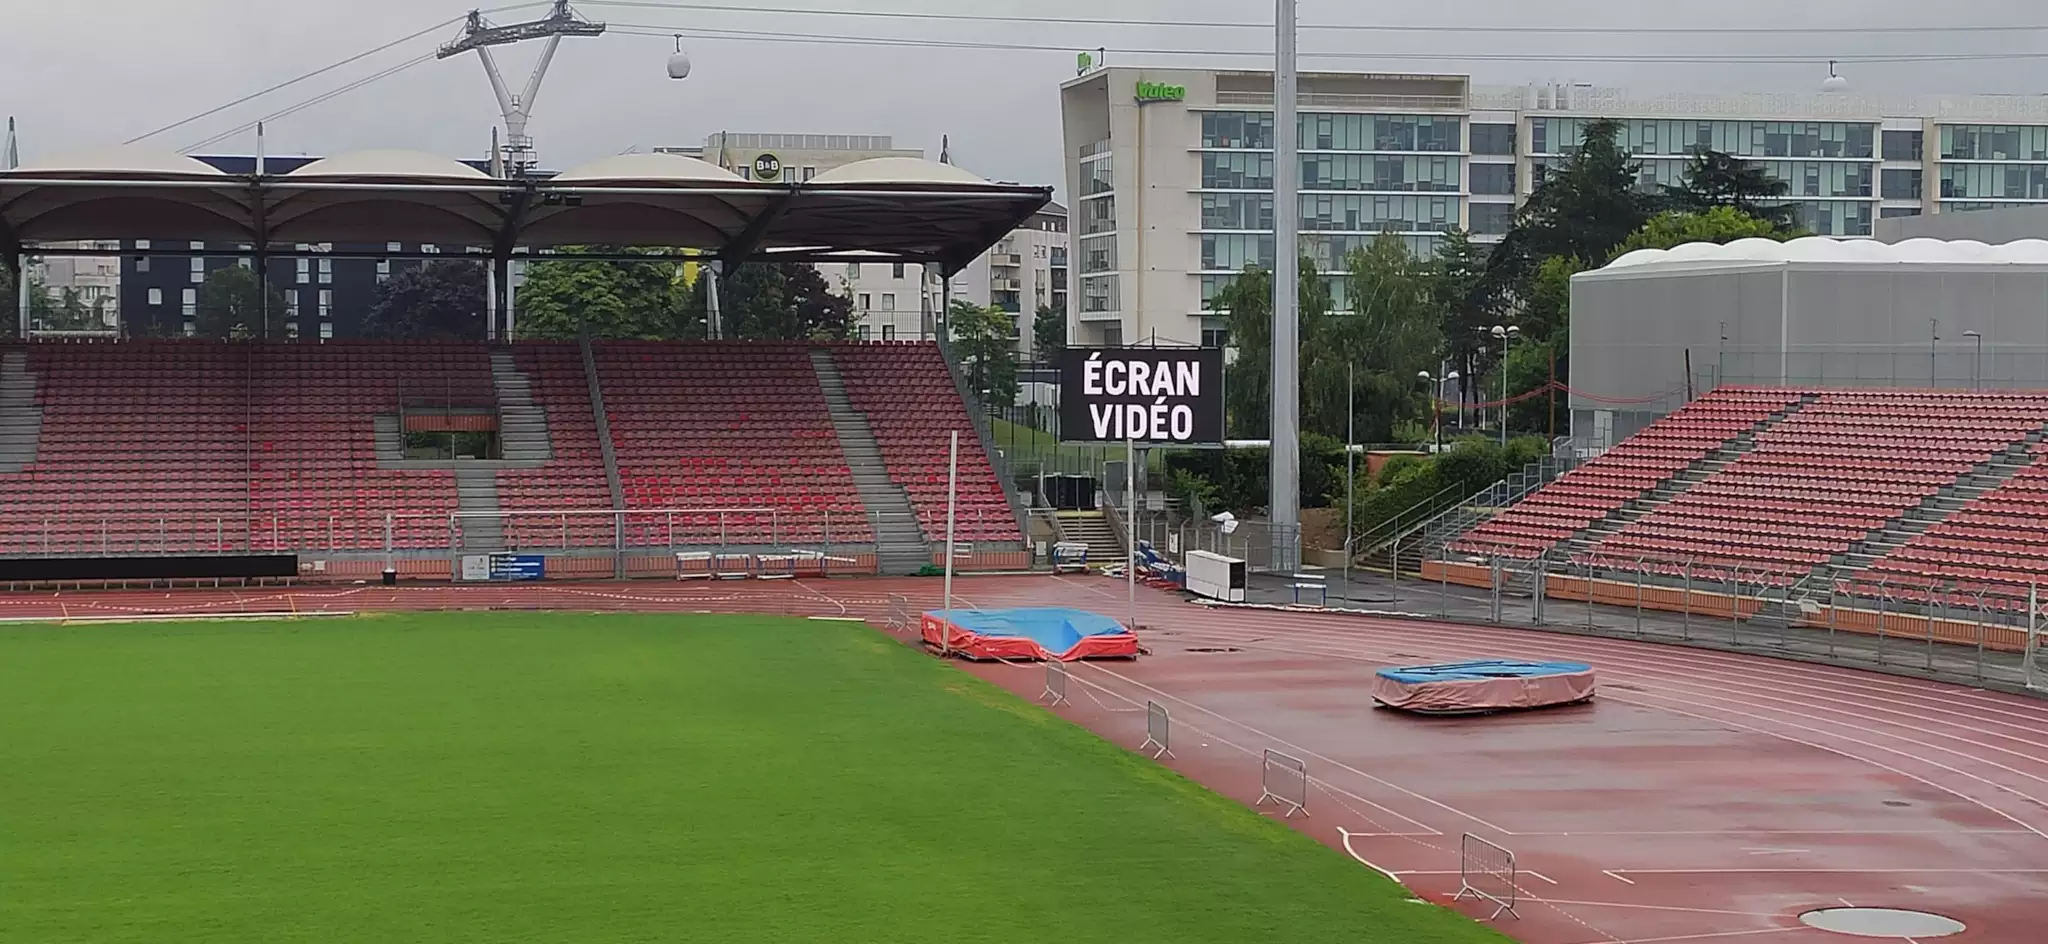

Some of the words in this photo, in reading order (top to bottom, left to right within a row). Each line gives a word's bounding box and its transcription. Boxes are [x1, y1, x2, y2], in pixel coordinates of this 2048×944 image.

[1136, 81, 1185, 98] Valeo
[1084, 352, 1200, 396] ÉCRAN
[1089, 396, 1193, 440] VIDÉO
